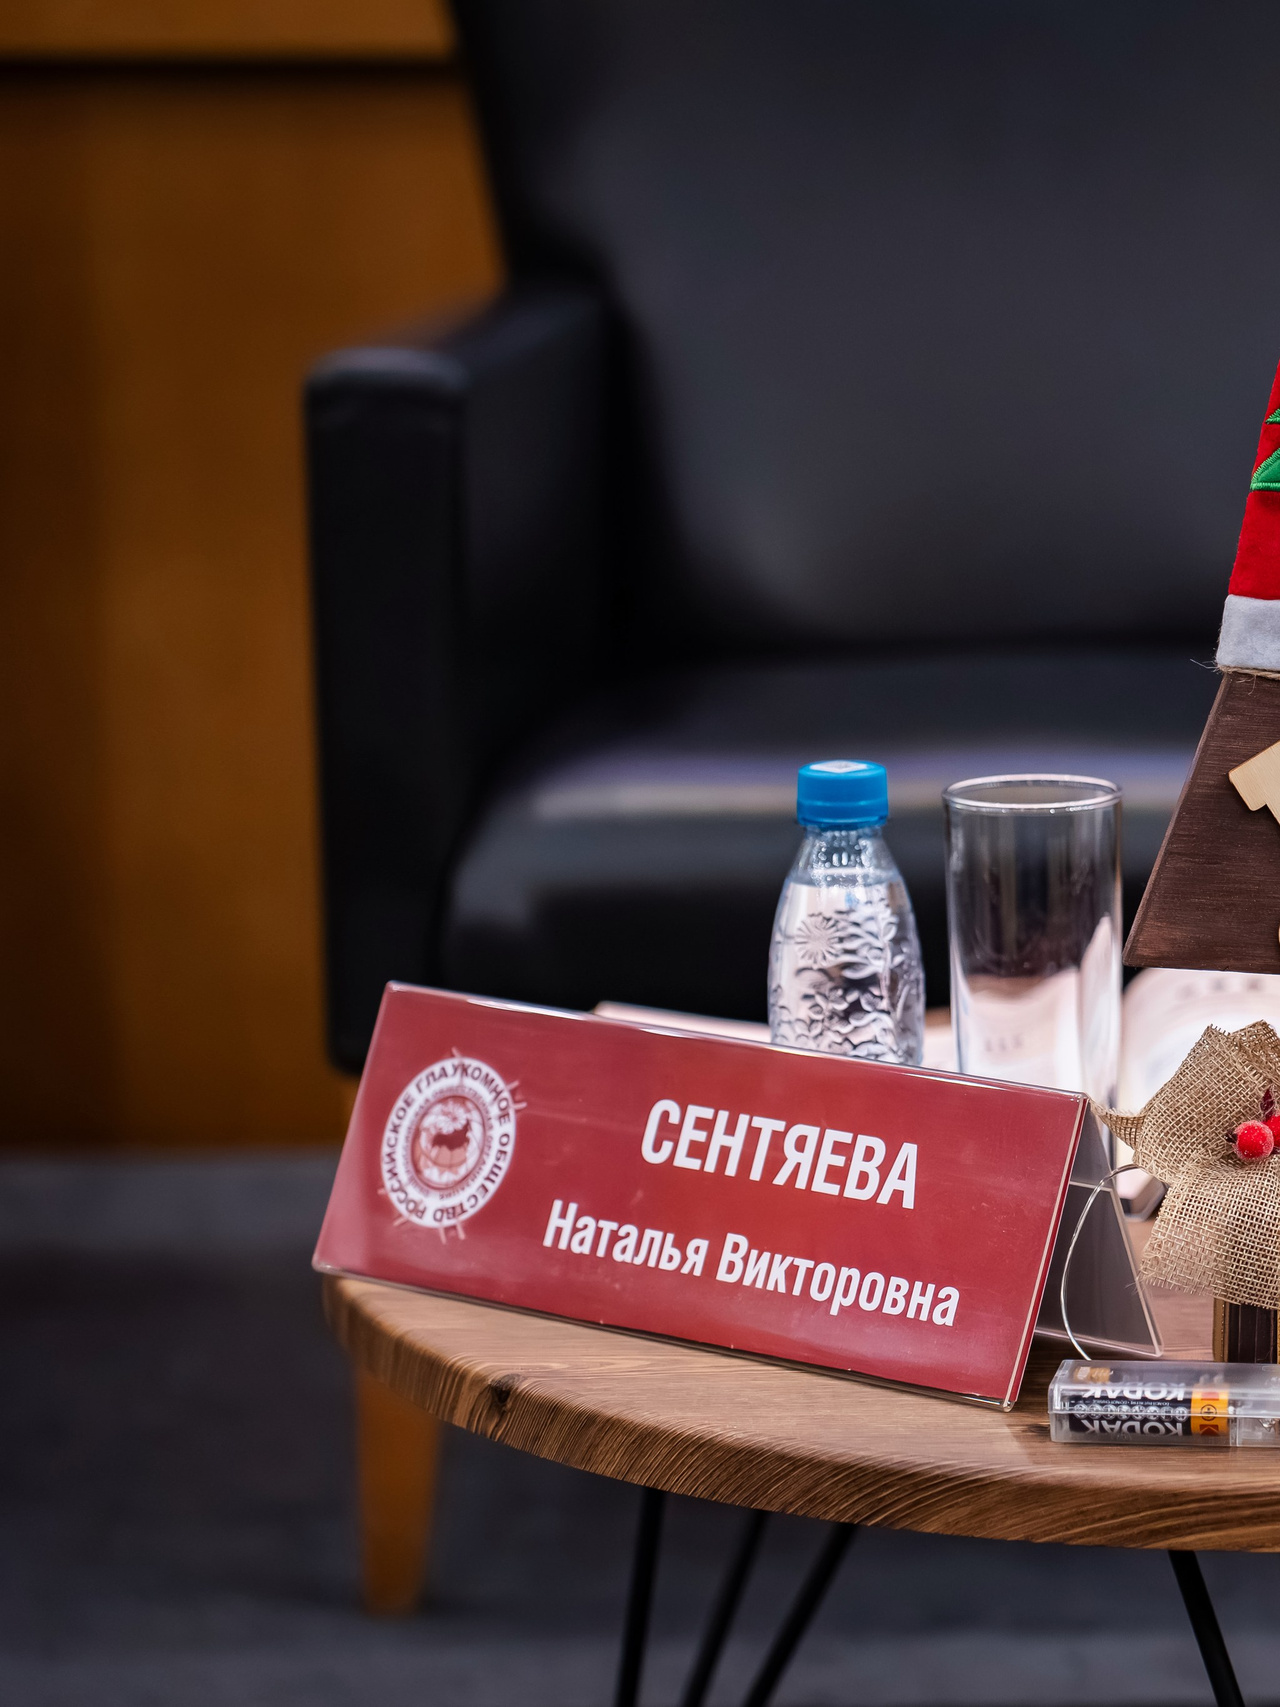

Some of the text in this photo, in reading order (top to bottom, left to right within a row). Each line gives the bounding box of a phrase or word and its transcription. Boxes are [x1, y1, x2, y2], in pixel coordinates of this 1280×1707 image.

[416, 1063, 511, 1127] ГЛАУКОМНОЕ
[432, 1132, 511, 1223] ОБЩЕСТВО
[641, 1099, 918, 1210] СЕНТЯЕВА
[542, 1199, 960, 1327] Наталья Викторовна
[1080, 1419, 1184, 1437] KODAK
[1081, 1381, 1187, 1401] KODAK
